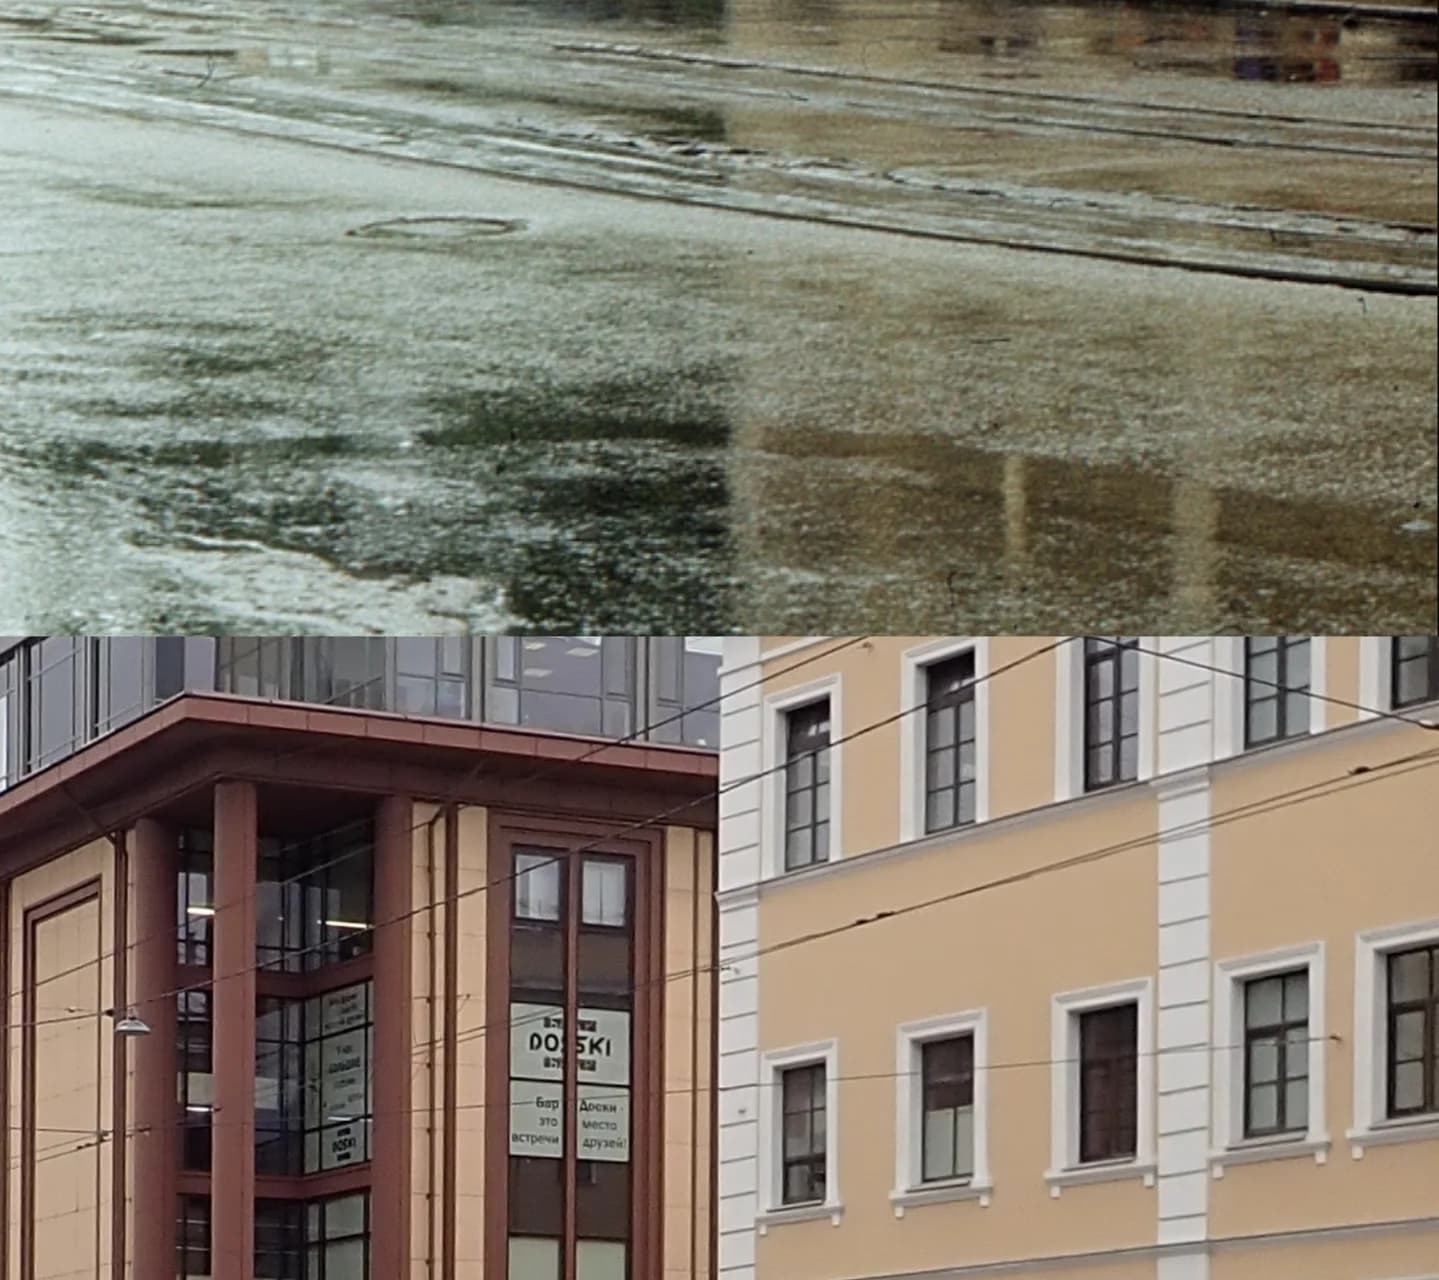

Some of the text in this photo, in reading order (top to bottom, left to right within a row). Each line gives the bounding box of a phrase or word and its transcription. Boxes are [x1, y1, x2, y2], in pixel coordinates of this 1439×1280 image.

[536, 1096, 618, 1113] Бар Доски
[539, 1117, 618, 1131] это место
[511, 1133, 559, 1147] встречи
